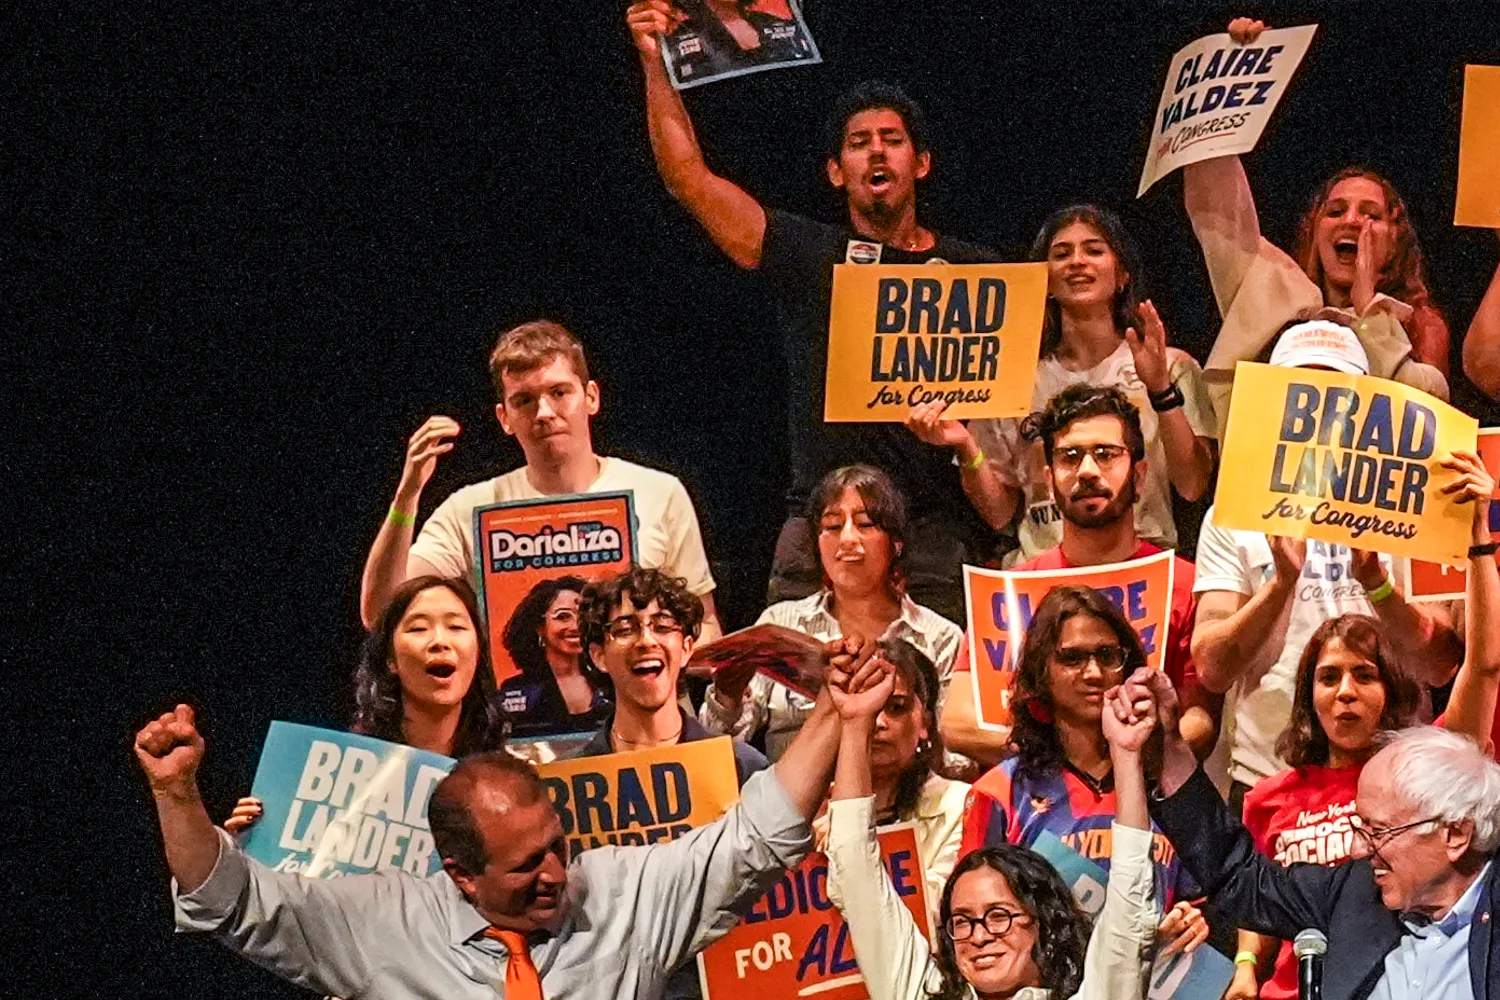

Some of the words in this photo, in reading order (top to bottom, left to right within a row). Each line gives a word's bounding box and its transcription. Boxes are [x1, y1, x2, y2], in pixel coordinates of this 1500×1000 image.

[1174, 45, 1285, 95] CLAIRE
[1161, 80, 1277, 134] VALDEZ
[1172, 112, 1251, 153] CONGRESS
[876, 278, 1007, 334] BRAD
[870, 336, 1001, 382] LANDER
[867, 385, 903, 409] for
[907, 384, 992, 411] Congress
[1280, 382, 1437, 460] BRAD
[1269, 443, 1429, 516] LANDER
[490, 523, 621, 560] Darializa
[1262, 497, 1306, 520] for
[1310, 501, 1418, 539] Congress
[493, 559, 525, 571] FOR
[532, 551, 621, 567] CONGRESS
[1300, 583, 1367, 602] CONGRE
[543, 762, 692, 836] BRAD
[279, 799, 436, 879] LANDER
[742, 850, 918, 924] EDICE
[735, 932, 793, 979] FOR
[796, 922, 857, 982] AL
